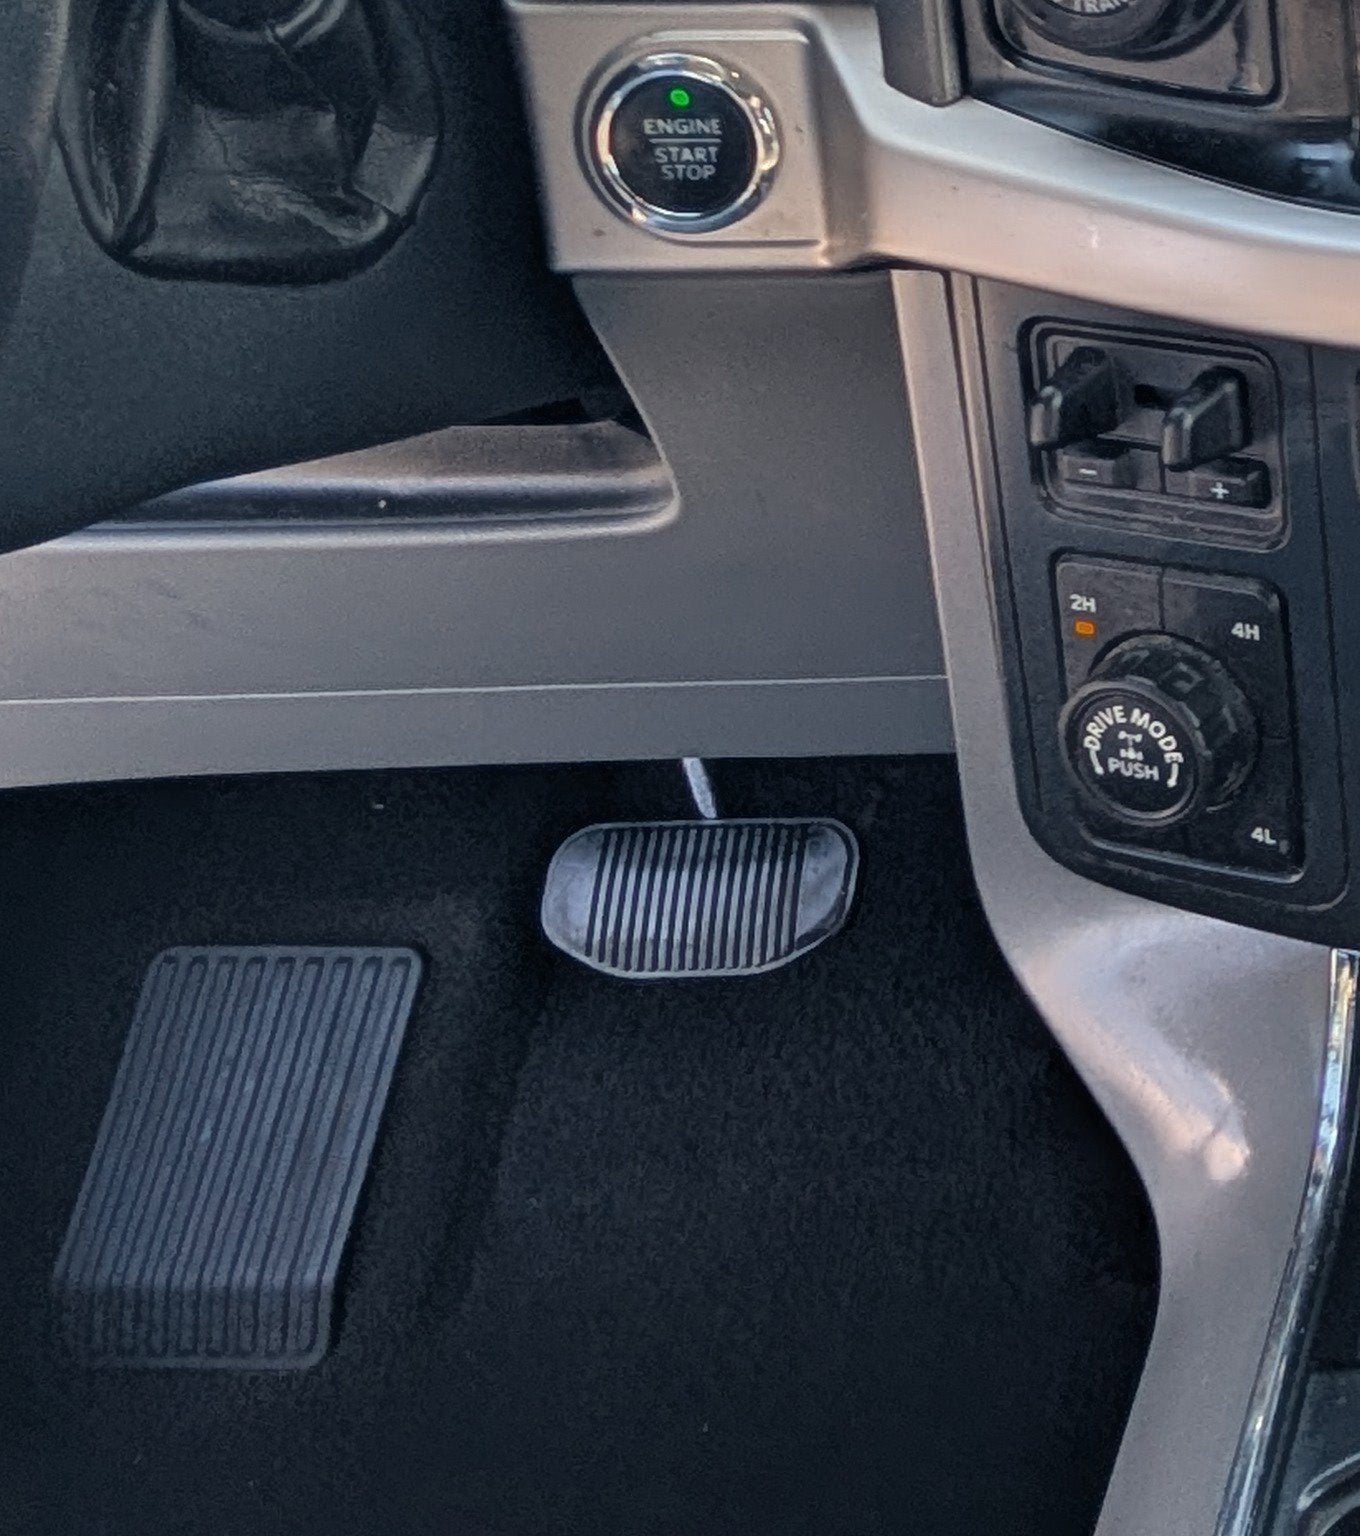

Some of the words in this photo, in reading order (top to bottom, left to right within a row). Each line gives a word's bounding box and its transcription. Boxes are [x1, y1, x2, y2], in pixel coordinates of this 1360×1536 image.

[643, 118, 723, 136] ENGINE
[654, 146, 718, 163] START
[661, 165, 716, 181] STOP
[1069, 595, 1096, 614] 2H
[1231, 622, 1260, 641] 4H
[1083, 705, 1127, 752] DRIVE
[1129, 708, 1185, 764] MODE
[1107, 756, 1160, 781] PUSH
[1251, 827, 1277, 845] 4L
